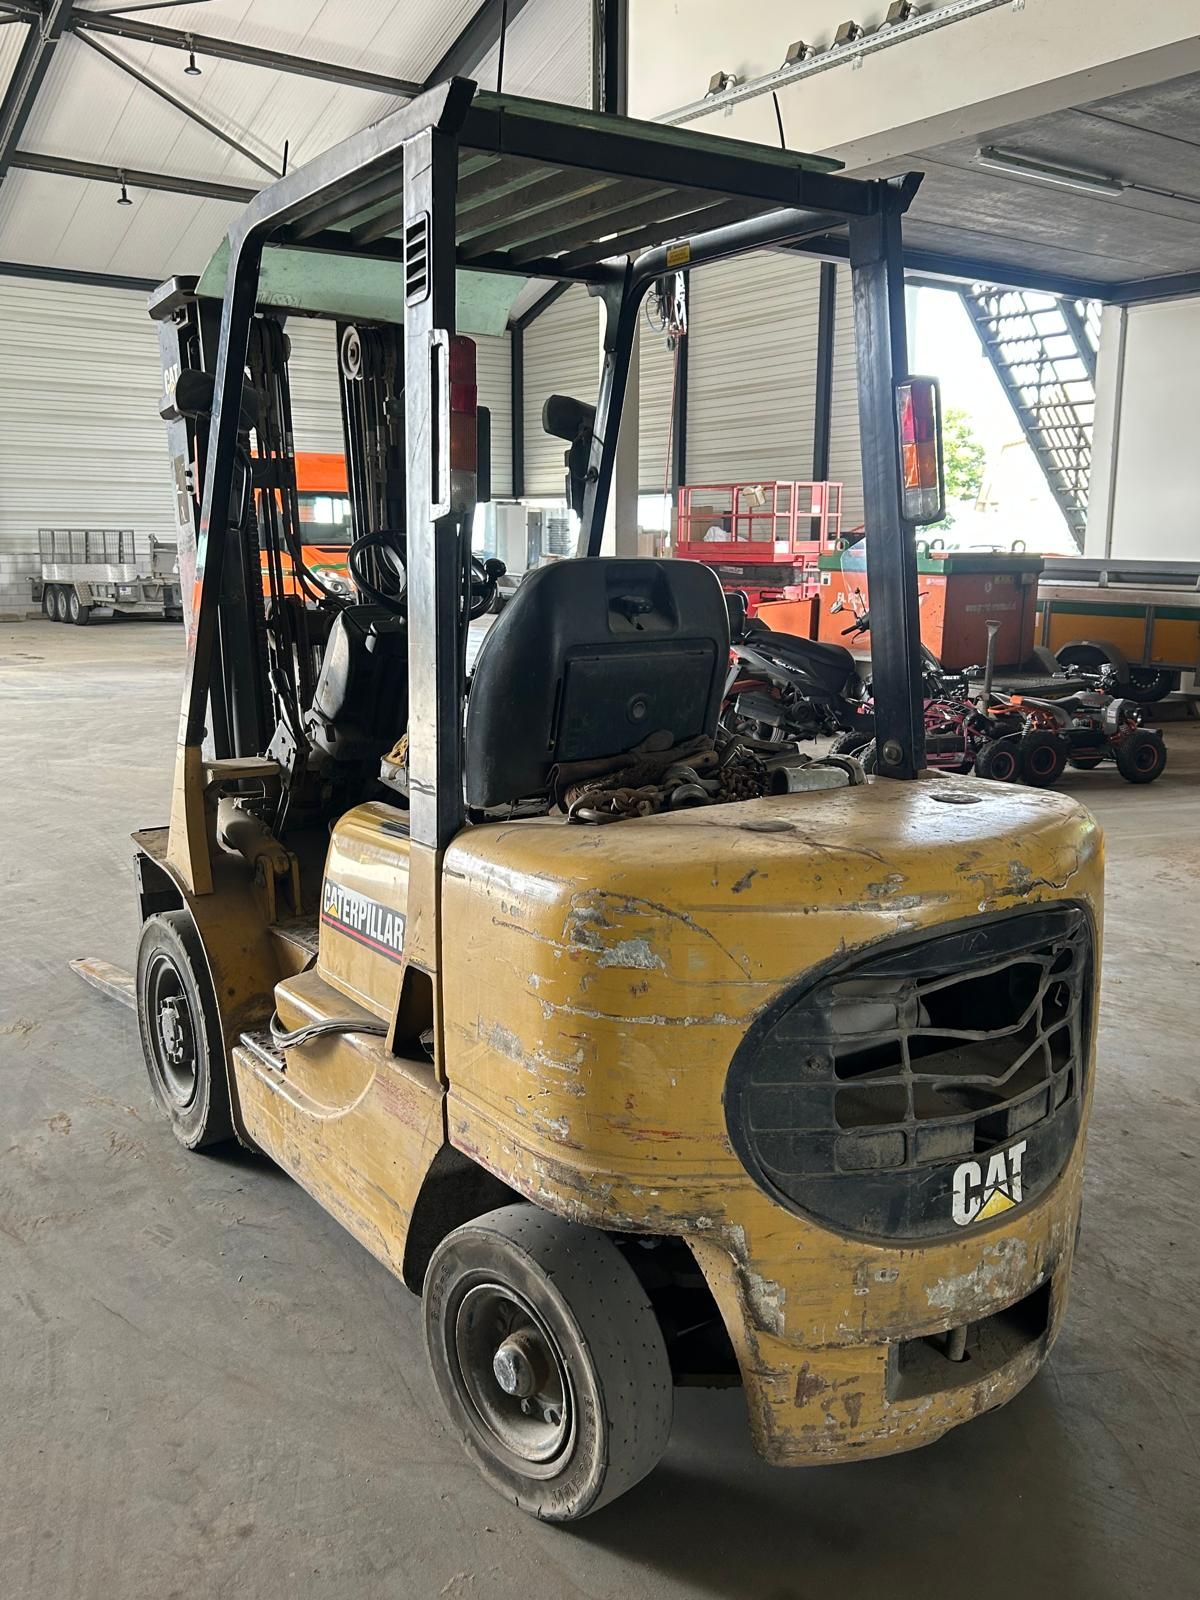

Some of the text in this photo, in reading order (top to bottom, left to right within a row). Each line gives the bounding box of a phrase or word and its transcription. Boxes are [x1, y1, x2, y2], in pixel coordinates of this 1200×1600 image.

[164, 363, 178, 395] CAT
[323, 883, 404, 951] CATERPILLAR
[952, 1140, 1027, 1226] CAT
